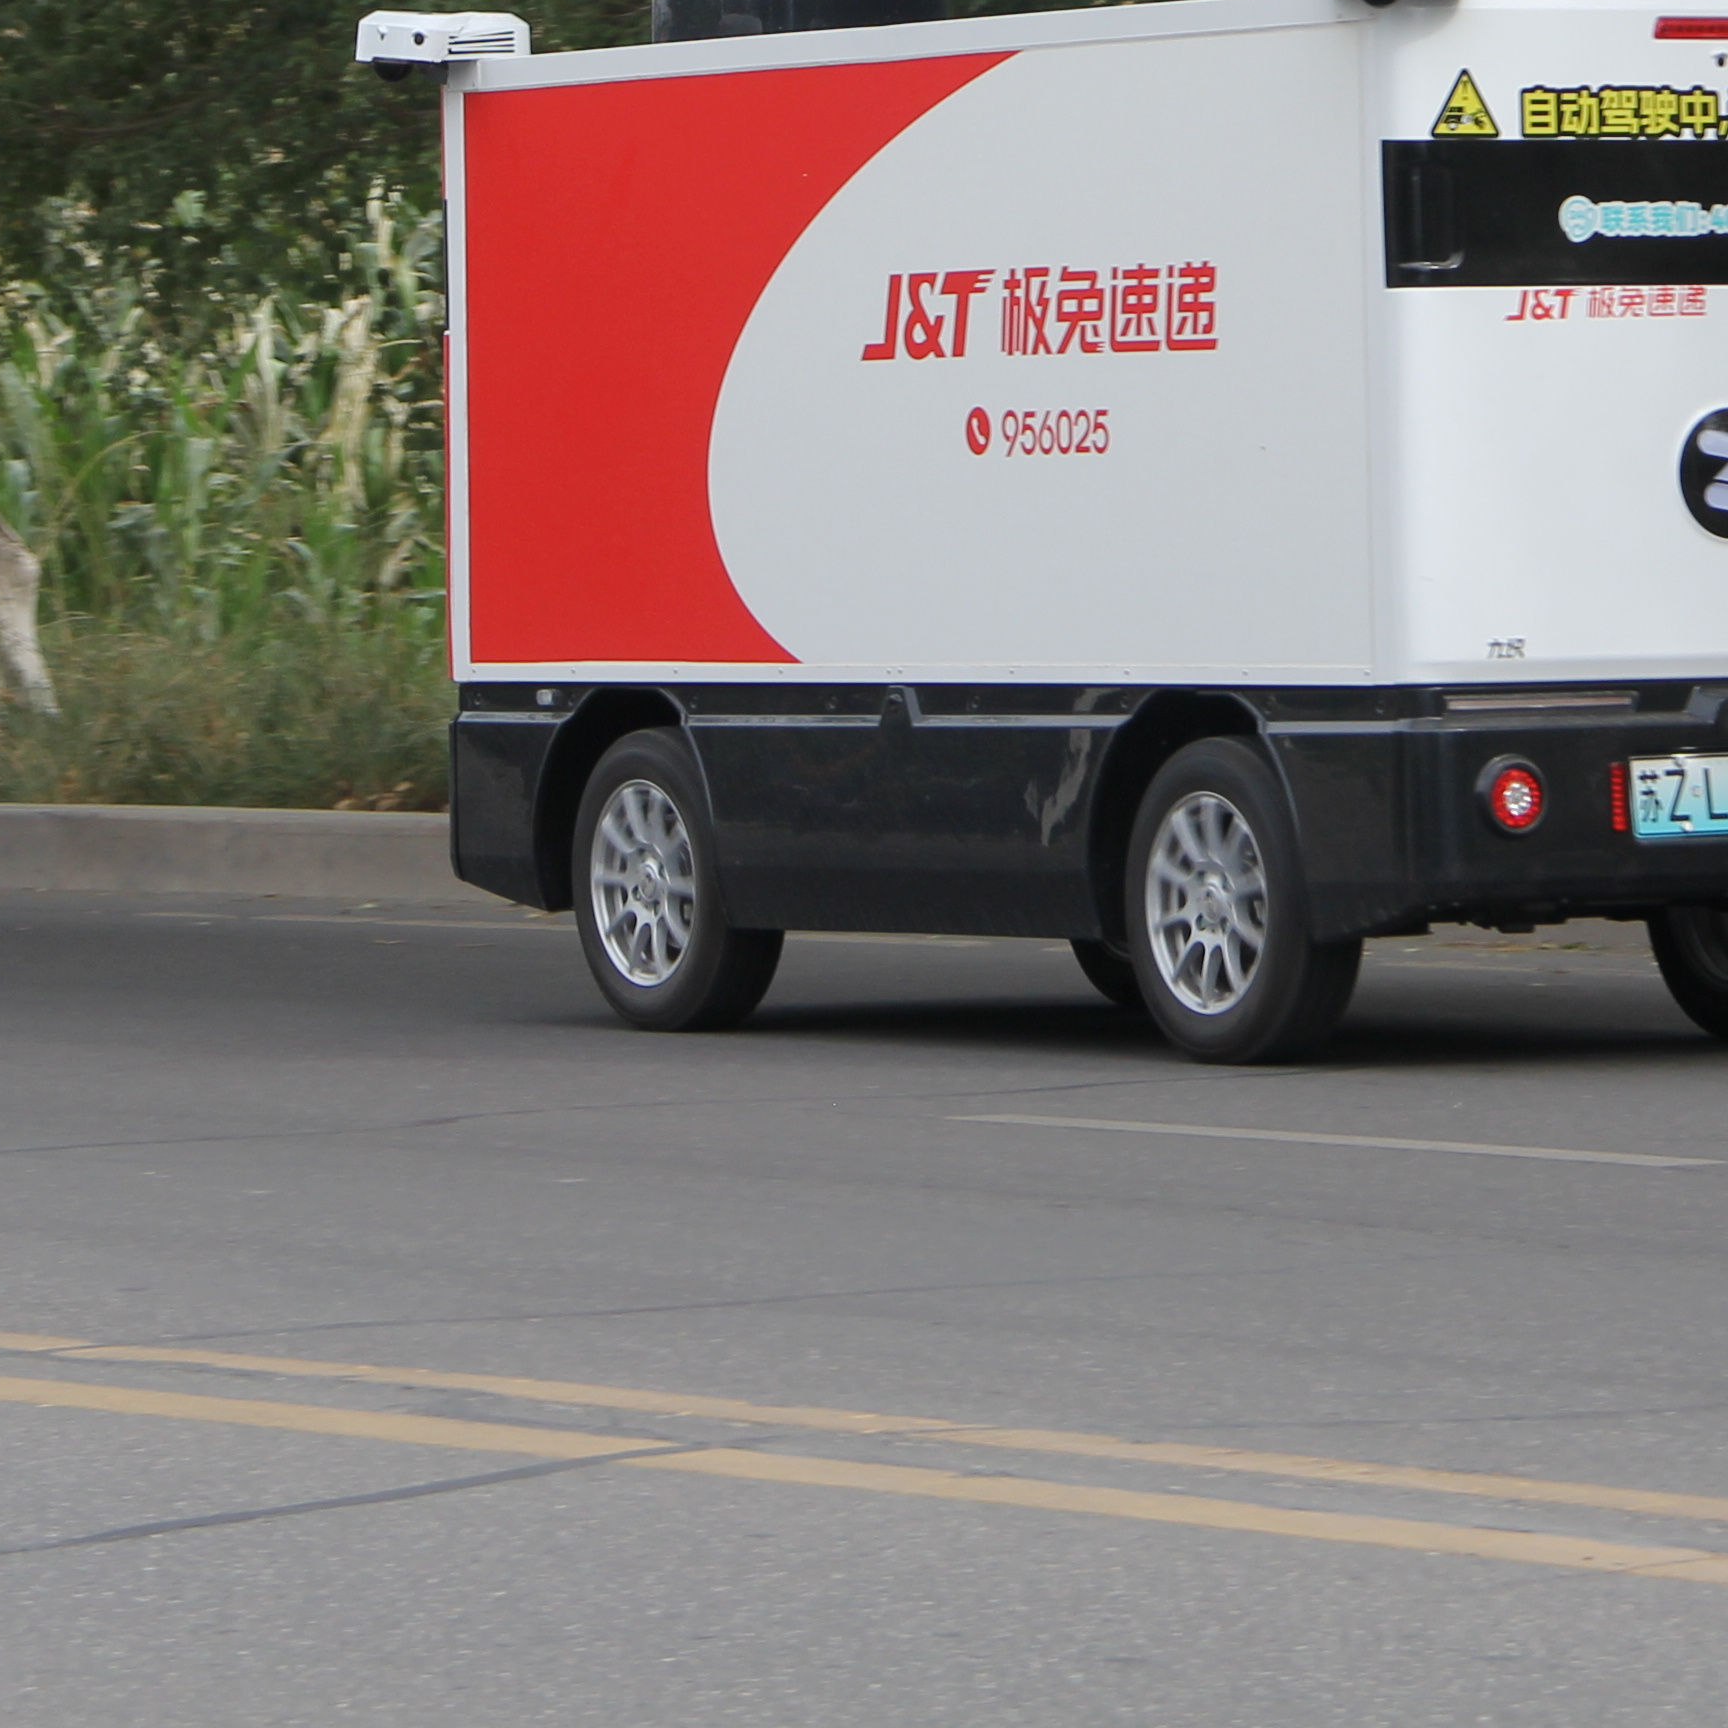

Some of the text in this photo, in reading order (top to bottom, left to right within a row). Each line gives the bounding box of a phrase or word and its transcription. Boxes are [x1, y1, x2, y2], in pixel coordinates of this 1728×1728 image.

[861, 261, 1219, 362] J&T 极兔速递
[1506, 288, 1577, 321] J&T
[1587, 286, 1708, 318] 极兔速递
[1002, 409, 1110, 456] 956025
